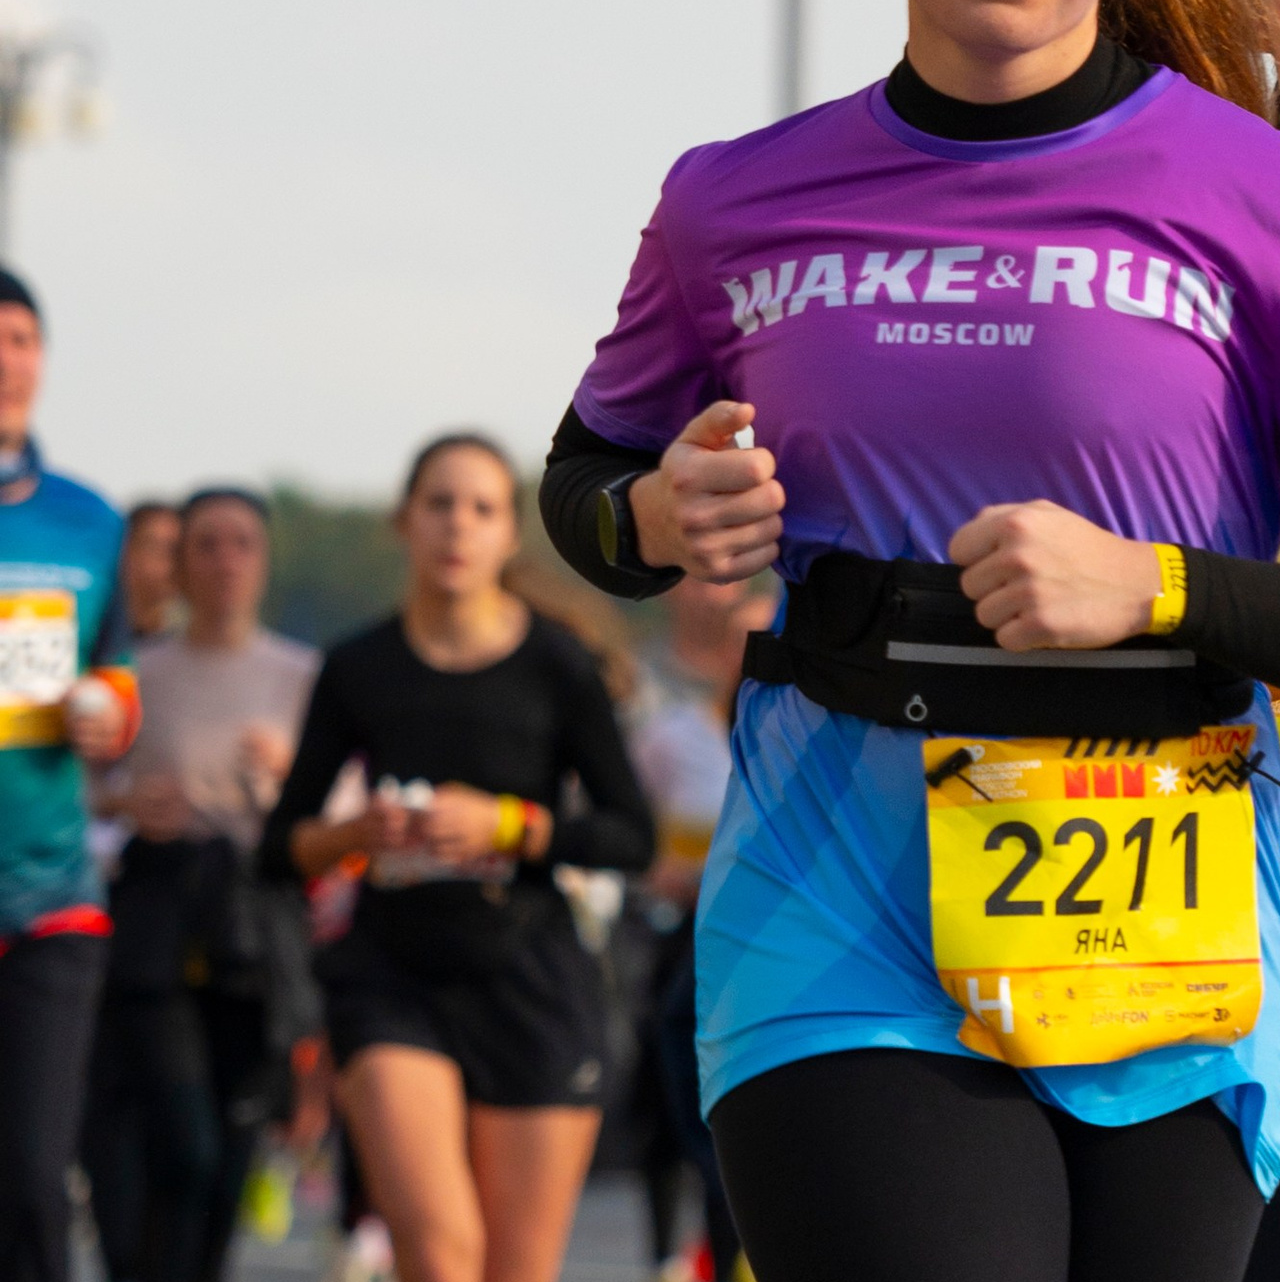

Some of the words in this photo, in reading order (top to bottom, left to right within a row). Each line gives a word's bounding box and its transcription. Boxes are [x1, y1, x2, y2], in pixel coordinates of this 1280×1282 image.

[875, 322, 1035, 346] MOSCOW
[983, 812, 1199, 917] 2211
[1074, 927, 1128, 955] ЯНА
